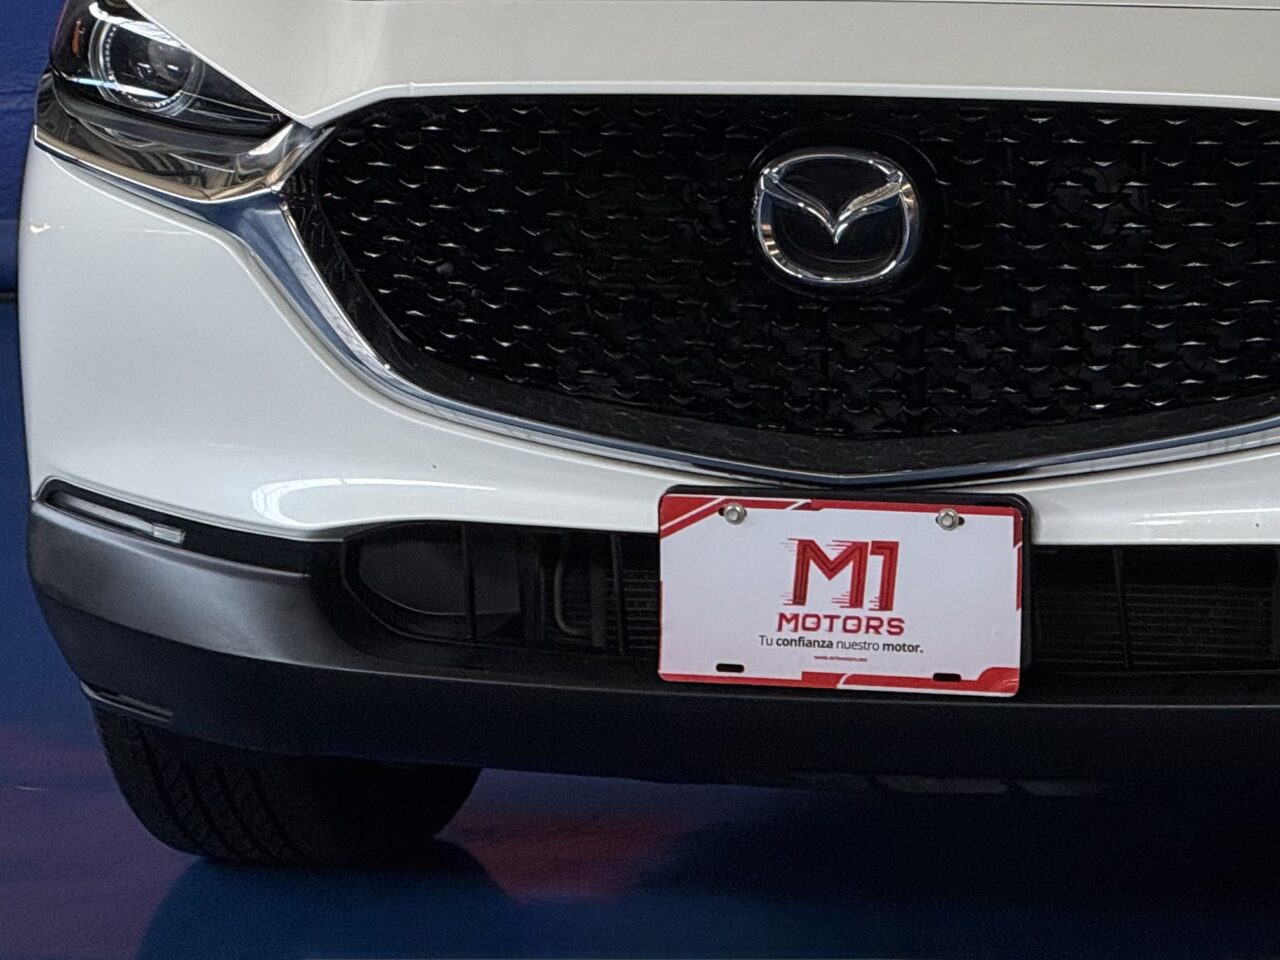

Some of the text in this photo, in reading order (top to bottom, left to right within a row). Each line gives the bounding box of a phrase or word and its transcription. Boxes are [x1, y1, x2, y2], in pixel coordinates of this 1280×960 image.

[781, 538, 899, 611] M1
[776, 612, 905, 636] MOTORS
[759, 635, 924, 654] Tu confianza nuestro motor.
